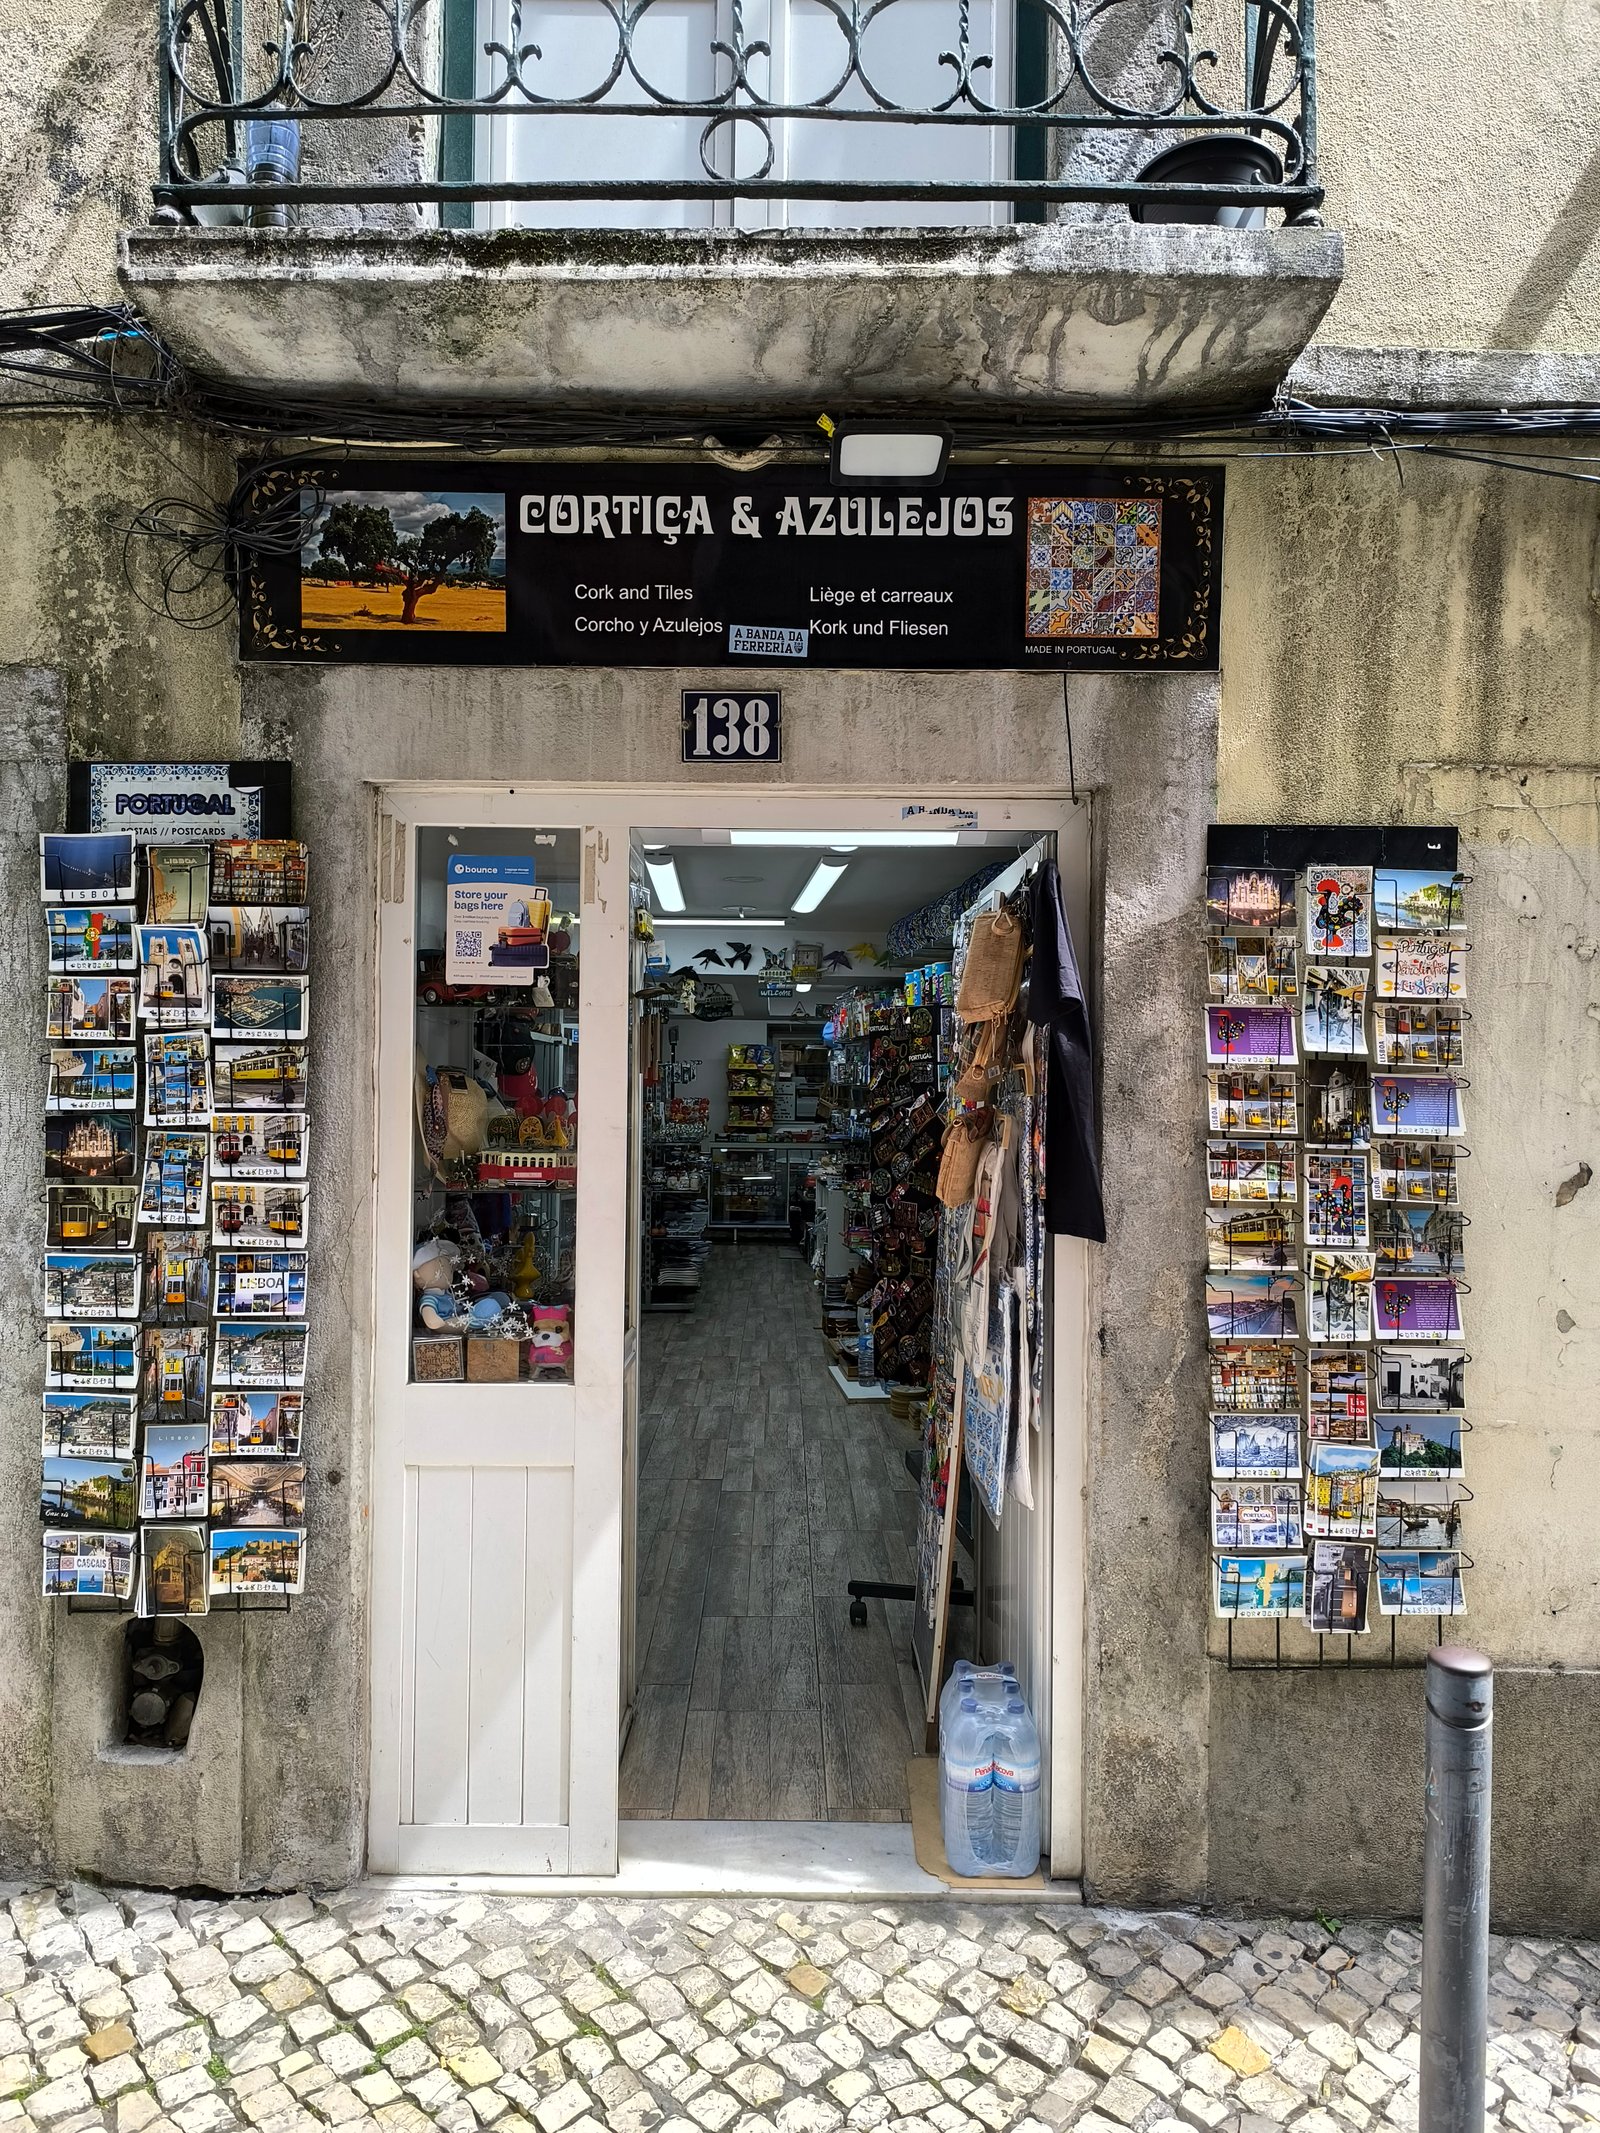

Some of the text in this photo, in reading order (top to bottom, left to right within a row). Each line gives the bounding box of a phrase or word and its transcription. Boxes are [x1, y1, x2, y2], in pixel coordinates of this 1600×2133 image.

[519, 494, 1014, 545] CORTIÇA & AZULEJOS
[574, 584, 693, 600] Cork and Tiles
[810, 587, 953, 606] Liège et carreaux
[574, 616, 723, 637] Corcho y Azulejos
[809, 619, 949, 636] Kork und Fliesen
[734, 628, 804, 642] A BANDA DA
[1025, 645, 1117, 656] MADE IN PORTUGAL
[692, 698, 771, 756] 138
[115, 793, 236, 815] PORTUGAL
[171, 827, 226, 836] POSTCARDS
[465, 865, 498, 874] bounce
[59, 889, 120, 900] LISBOA
[454, 890, 508, 902] Store your
[454, 901, 504, 912] bags here
[909, 1053, 933, 1062] PORTUGAL
[1378, 1041, 1386, 1063] LISBOA
[1211, 1107, 1219, 1129] LISBOA
[1373, 1177, 1382, 1199] LISBOA
[239, 1277, 285, 1290] LISBOA
[1350, 1397, 1365, 1406] Lis
[1350, 1405, 1365, 1413] boa
[76, 1558, 107, 1569] CASCAIS
